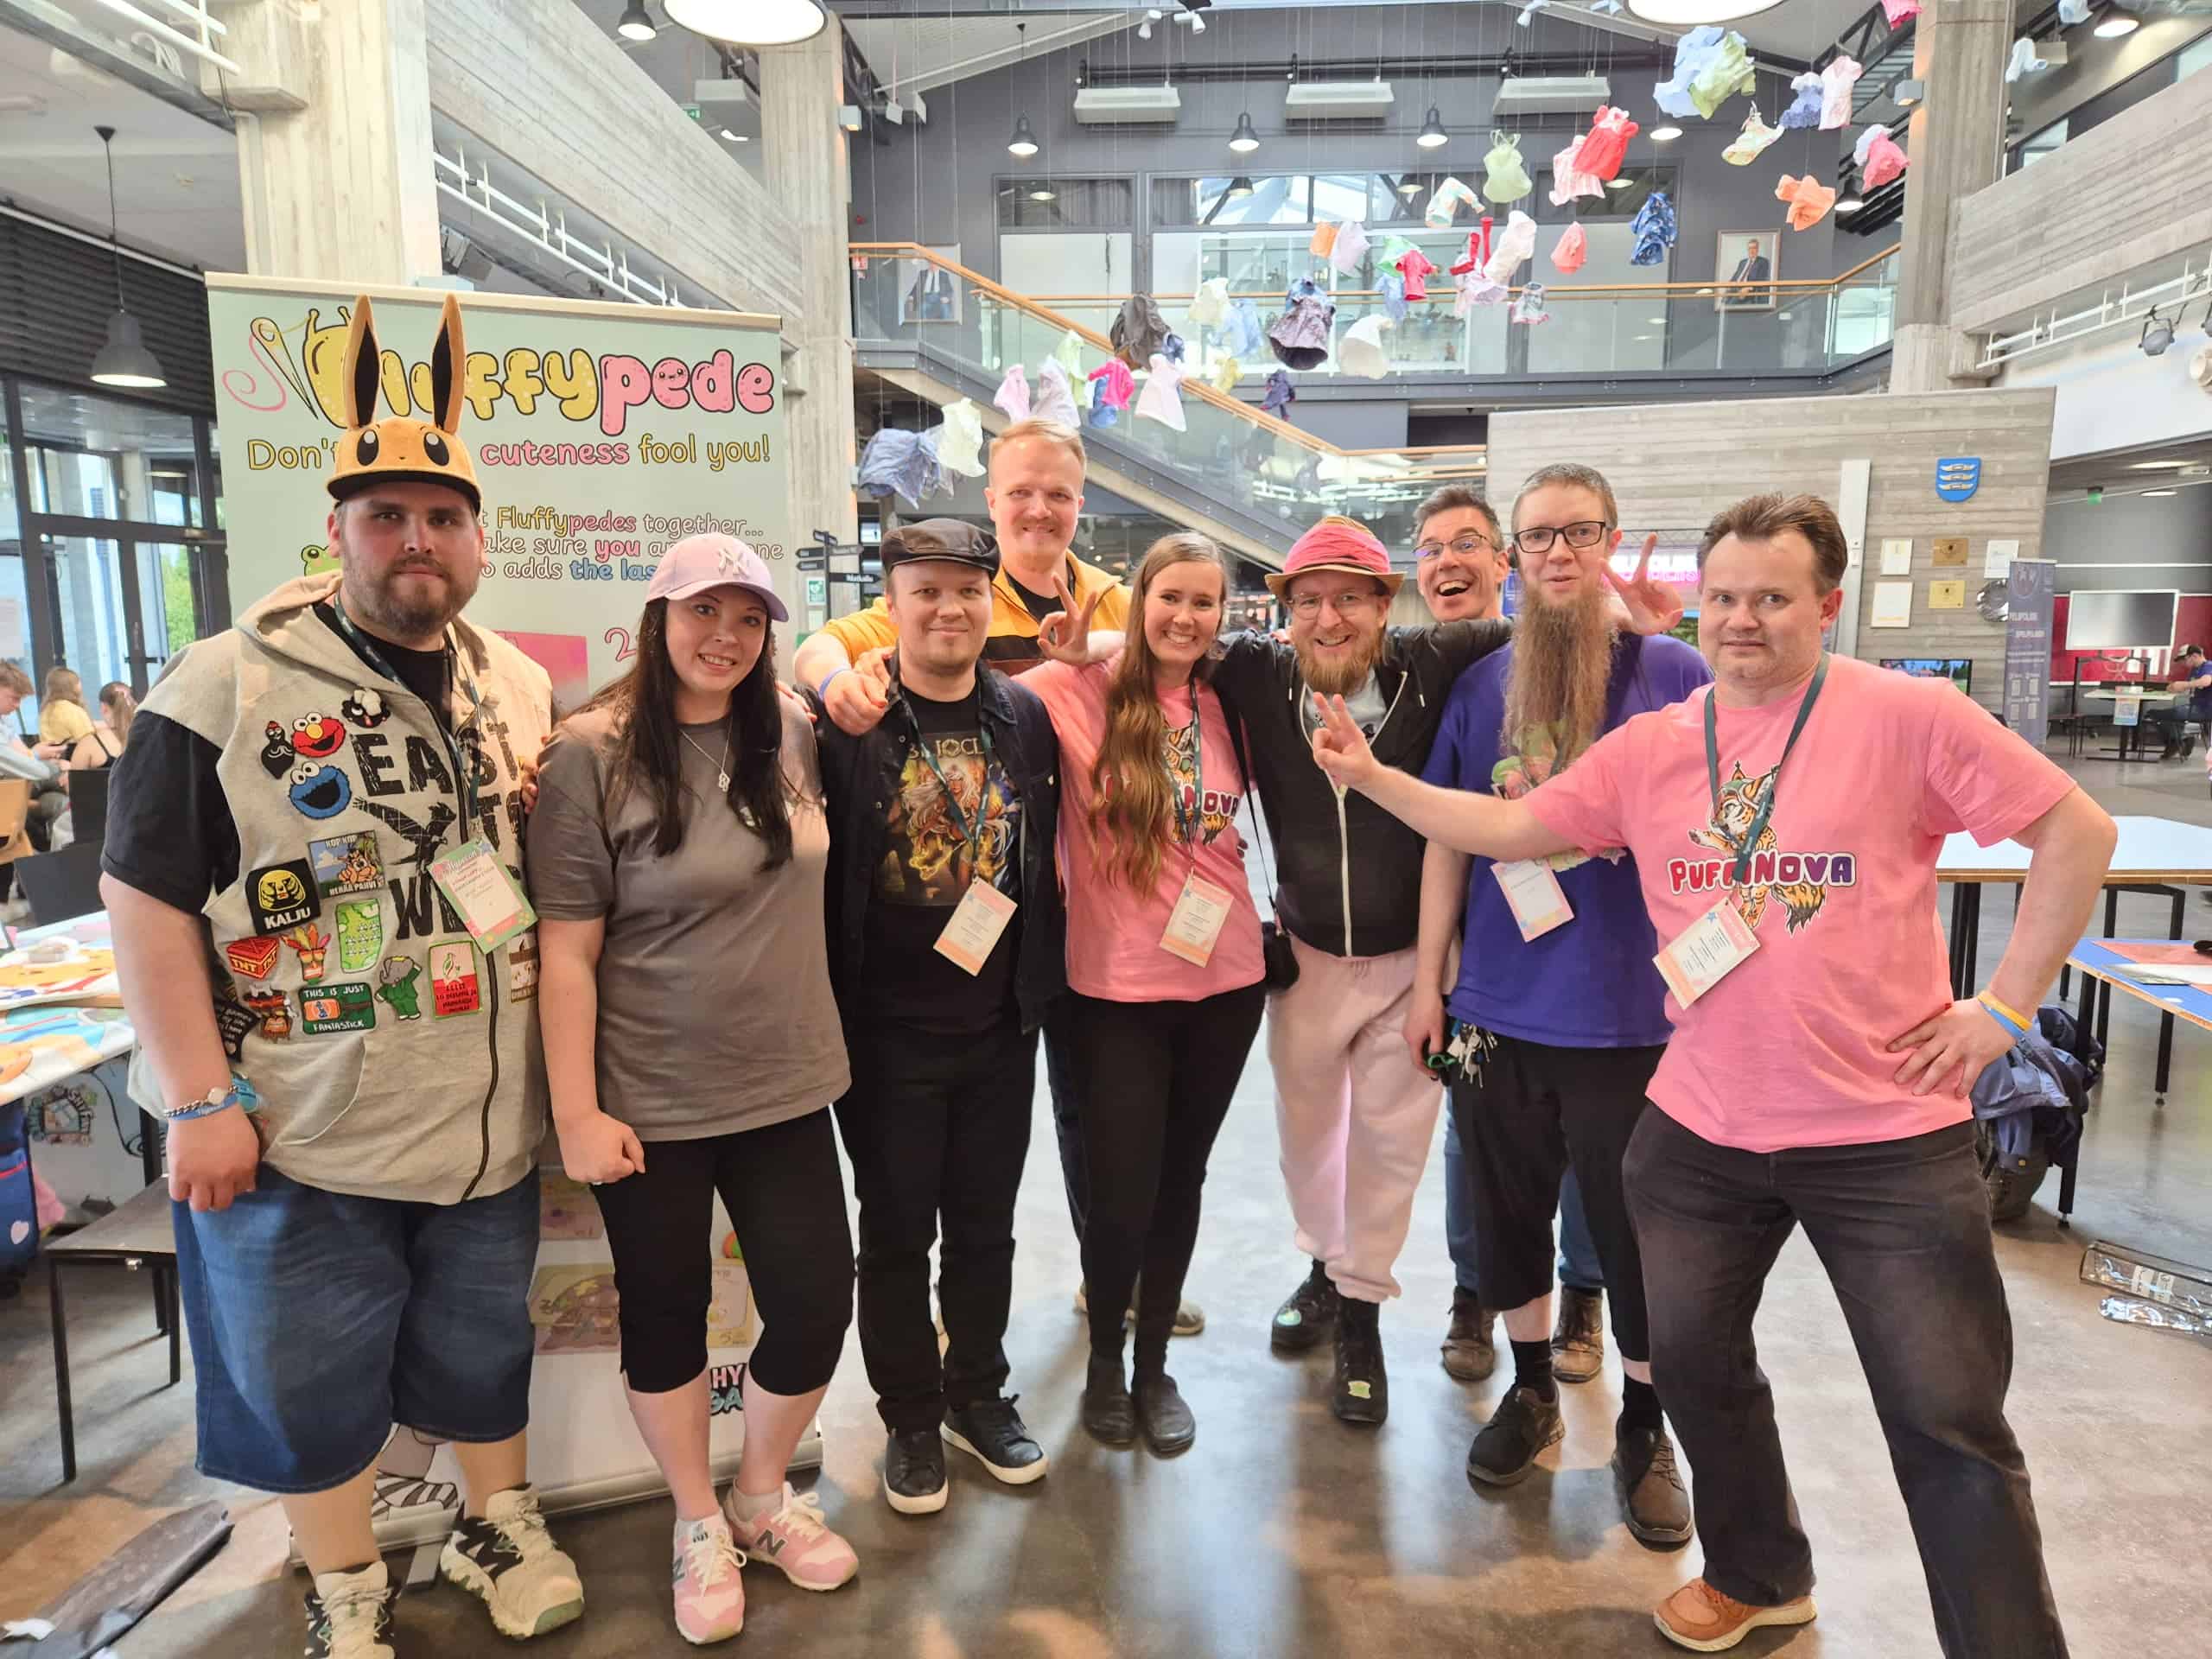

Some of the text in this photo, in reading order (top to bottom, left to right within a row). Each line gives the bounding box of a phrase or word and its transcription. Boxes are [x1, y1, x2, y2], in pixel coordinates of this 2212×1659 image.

[247, 433, 772, 472] Don't cuteness fool you!
[497, 505, 637, 537] Fluffypedes
[644, 512, 764, 538] together...
[483, 531, 526, 555] ake
[532, 537, 588, 556] sure
[594, 540, 641, 563] you
[503, 556, 563, 580] adds
[569, 558, 614, 582] the
[620, 559, 658, 582] las
[264, 906, 311, 930] KALJU
[303, 984, 365, 998] THIS IS JUST
